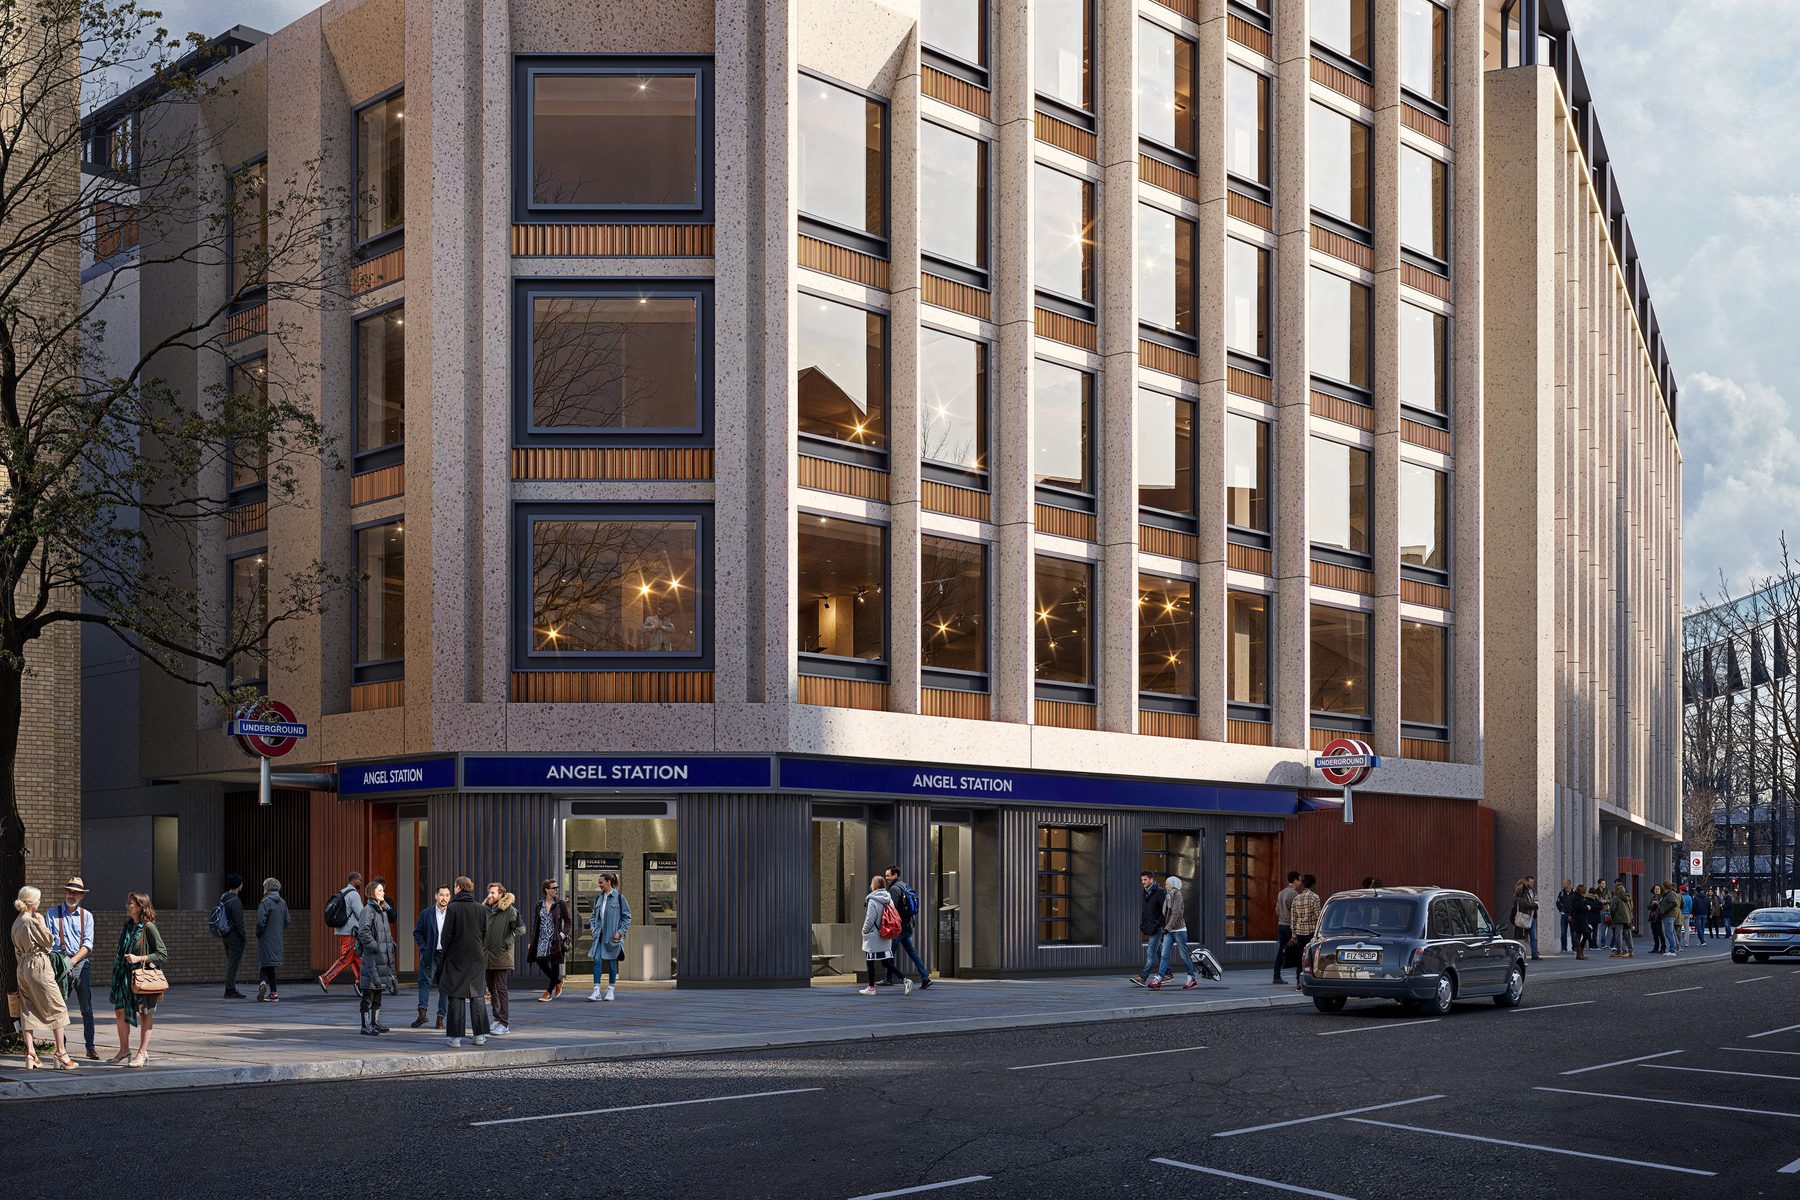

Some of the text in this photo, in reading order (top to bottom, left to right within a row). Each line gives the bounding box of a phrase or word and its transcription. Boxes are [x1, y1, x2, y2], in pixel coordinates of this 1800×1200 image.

[242, 723, 305, 735] UNDERGROUND
[1316, 757, 1364, 767] UNDERGROUND
[363, 768, 423, 785] ANGEL STATION
[546, 764, 688, 780] ANGEL STATION
[912, 774, 1013, 792] ANGEL STATION
